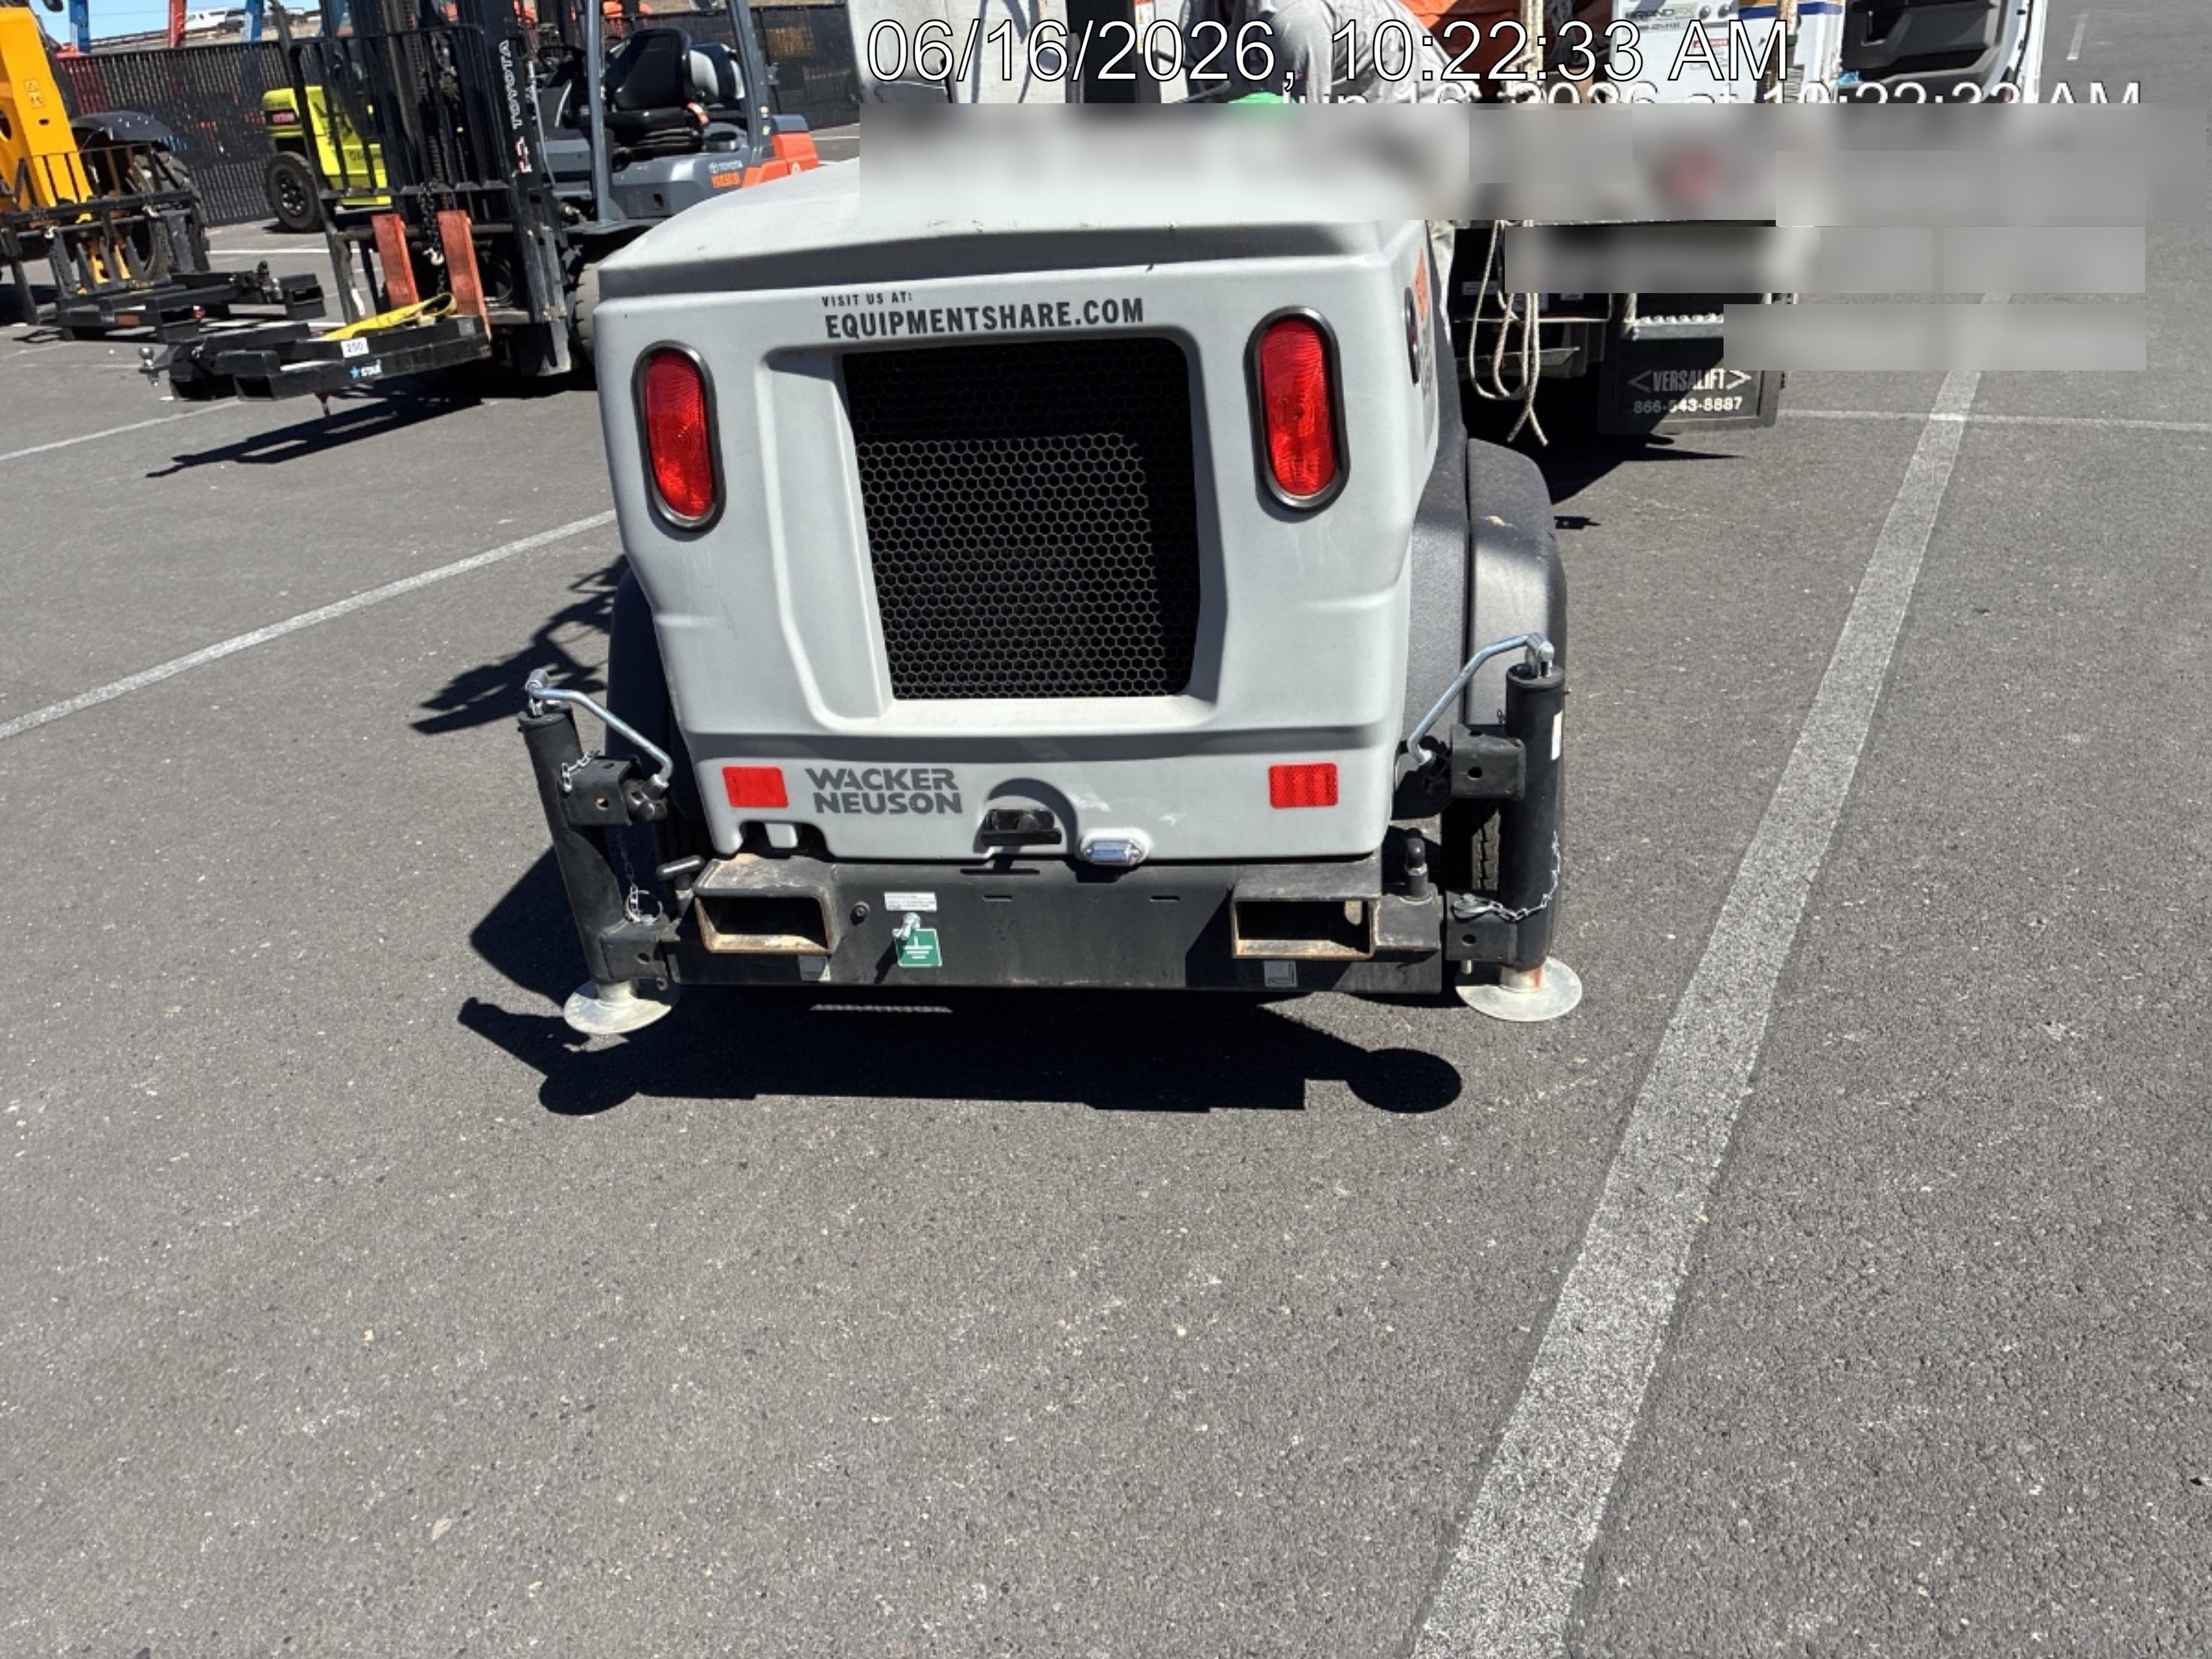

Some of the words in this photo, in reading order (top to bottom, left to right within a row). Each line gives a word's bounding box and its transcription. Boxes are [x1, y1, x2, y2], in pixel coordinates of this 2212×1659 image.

[498, 39, 523, 130] TOYOTA
[821, 294, 860, 308] VISIT
[866, 292, 884, 305] US
[891, 291, 914, 304] AT:
[825, 297, 1144, 340] EQUIPMENTSHARE.COM
[804, 767, 959, 791] WACKER
[812, 792, 963, 814] NEUSON
